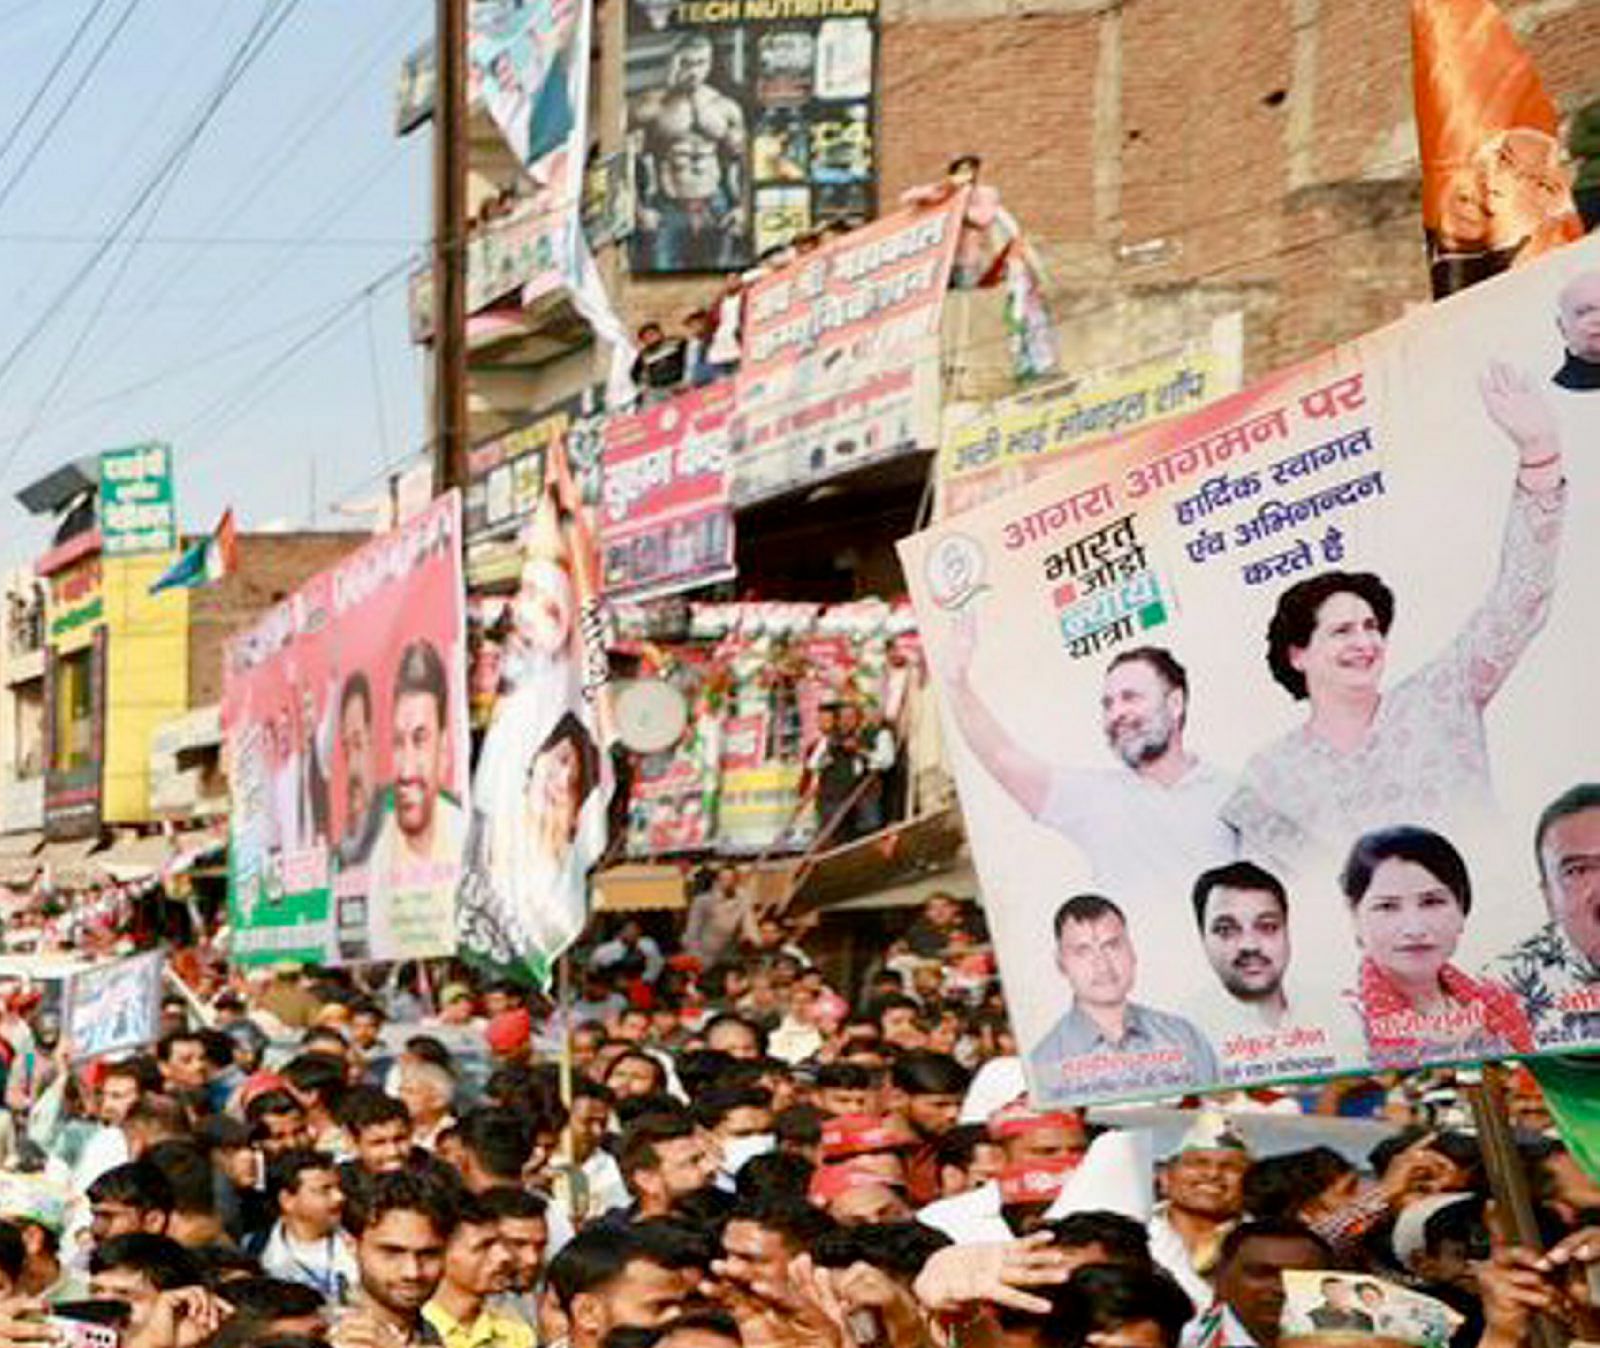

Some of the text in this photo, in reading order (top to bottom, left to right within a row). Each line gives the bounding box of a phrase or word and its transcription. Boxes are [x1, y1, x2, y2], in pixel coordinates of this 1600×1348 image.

[679, 0, 739, 23] TECH
[1003, 373, 1368, 551] आगरा आगमन पर
[1175, 427, 1374, 525] हार्दिक स्वागत
[1043, 512, 1138, 582] भारत
[1242, 538, 1314, 585] करते
[1065, 614, 1135, 660] यात्रा
